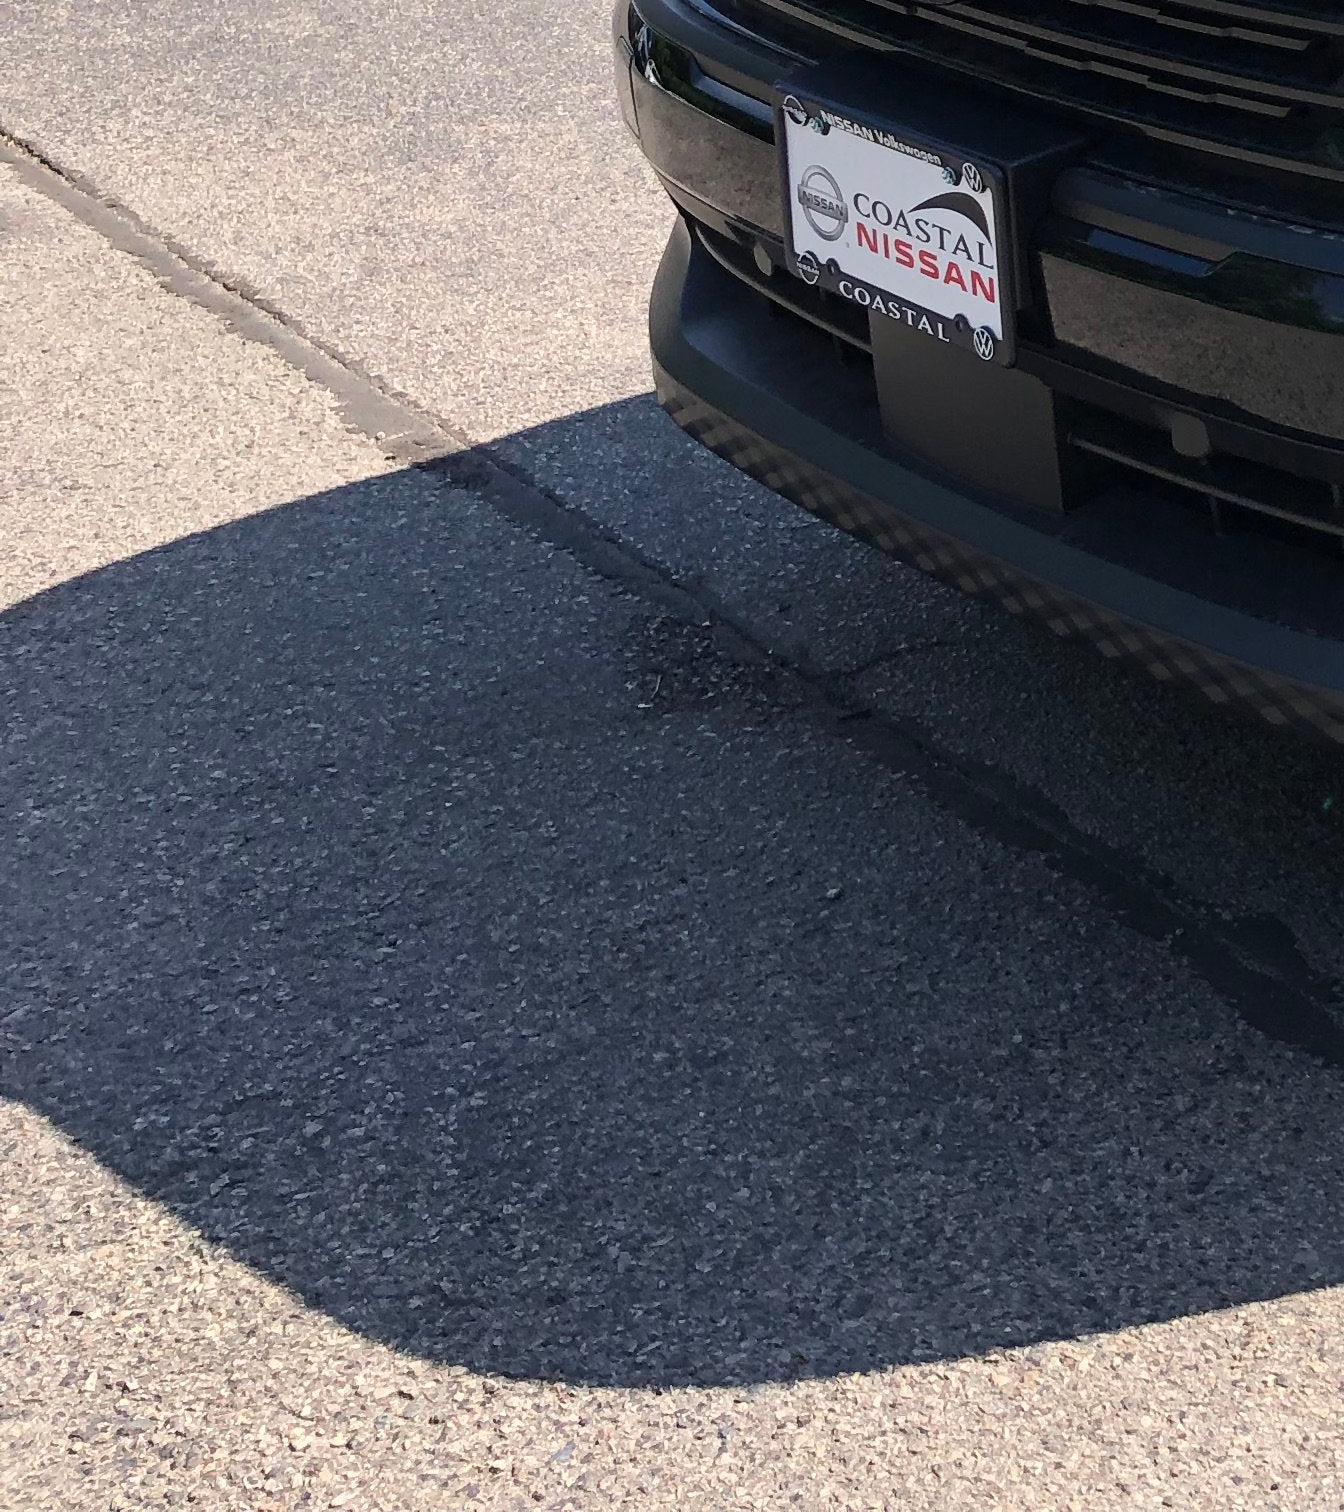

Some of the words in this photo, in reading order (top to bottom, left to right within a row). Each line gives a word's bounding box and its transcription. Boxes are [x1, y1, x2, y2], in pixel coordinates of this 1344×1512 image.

[820, 109, 875, 142] NISSAN
[873, 129, 943, 166] Volkswagen
[802, 190, 845, 217] NISSAN
[853, 192, 995, 270] COASTAL
[856, 221, 996, 304] NISSAN
[839, 280, 950, 343] COASTAL
